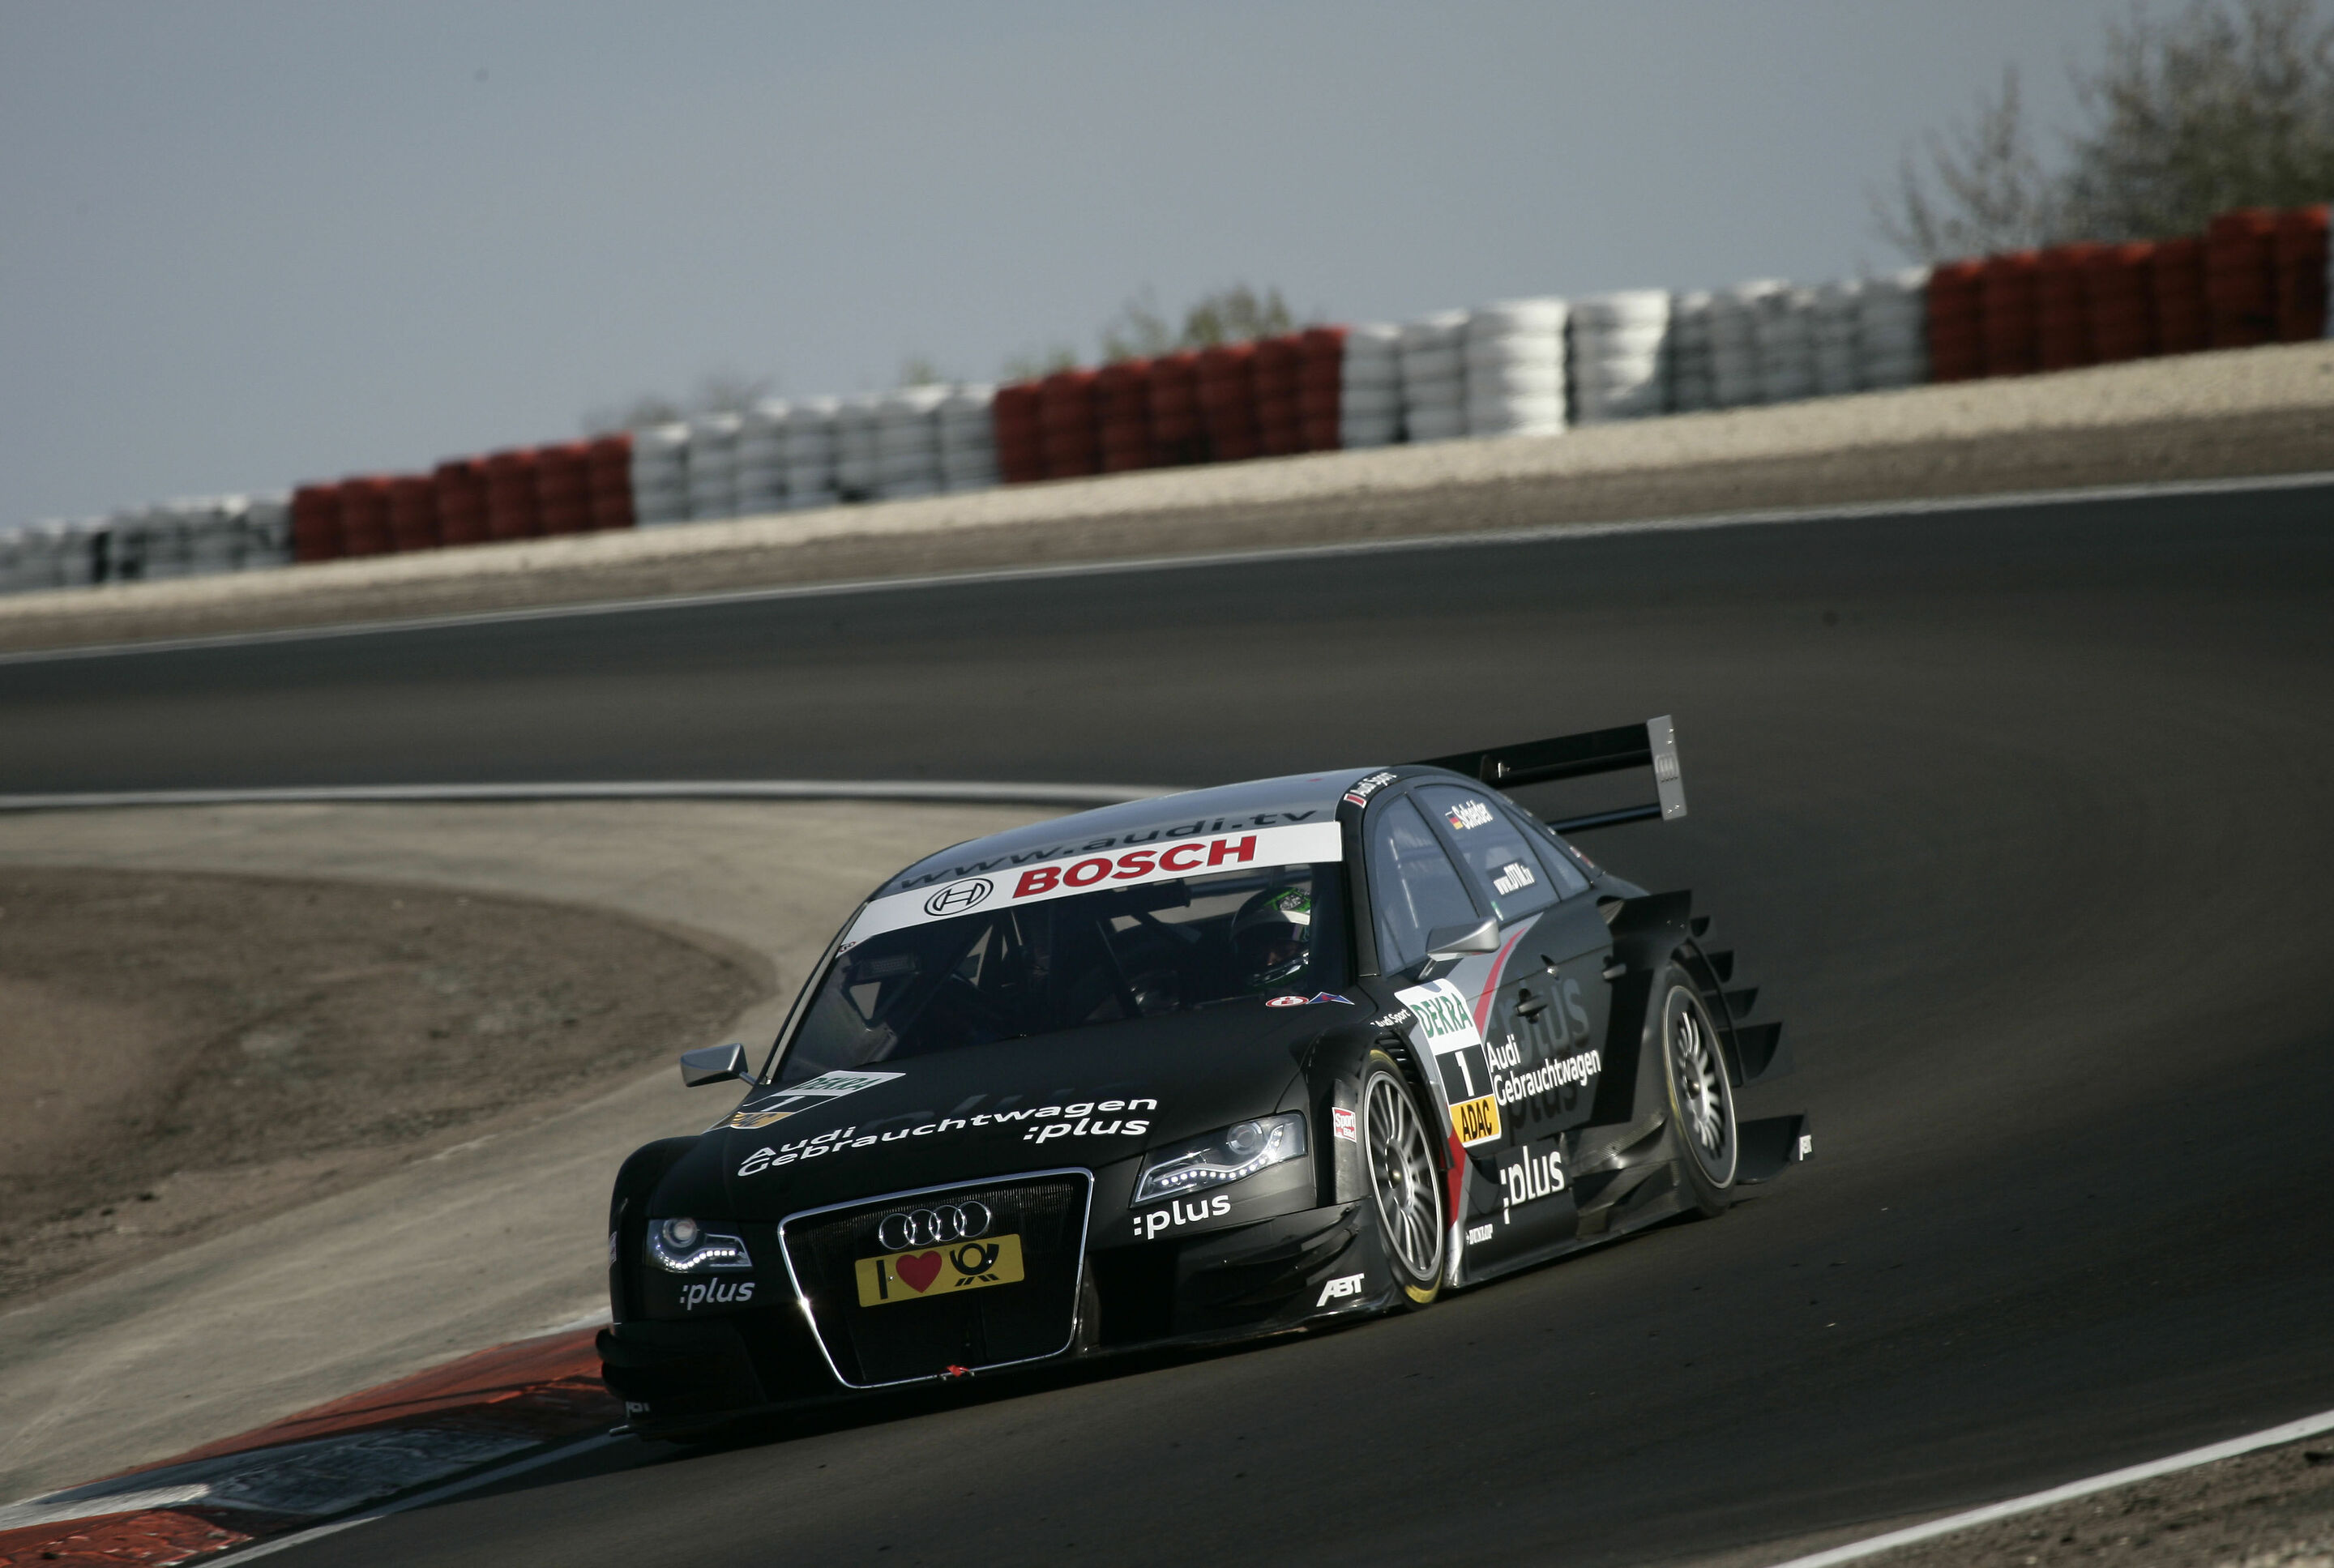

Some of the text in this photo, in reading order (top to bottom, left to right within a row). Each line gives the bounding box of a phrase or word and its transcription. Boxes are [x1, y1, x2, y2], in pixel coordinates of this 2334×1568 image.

[901, 810, 1317, 889] www.audi.tv
[1012, 835, 1258, 899] BOSCH
[1410, 993, 1473, 1038] DEKRA
[1455, 1051, 1475, 1096] 1
[1486, 1034, 1522, 1073] Audi
[789, 1078, 882, 1091] DEKRA
[1494, 1049, 1601, 1106] Gebrauchtwagen
[760, 1096, 806, 1113] 1
[1460, 1099, 1493, 1140] ADAC
[737, 1098, 1158, 1177] Gebrauchtwagen
[741, 1126, 857, 1165] Audi
[1023, 1118, 1151, 1144] :plus
[1499, 1145, 1565, 1224] :plus
[1133, 1194, 1231, 1240] :plus
[680, 1277, 755, 1310] :plus
[1316, 1272, 1365, 1307] ABT
